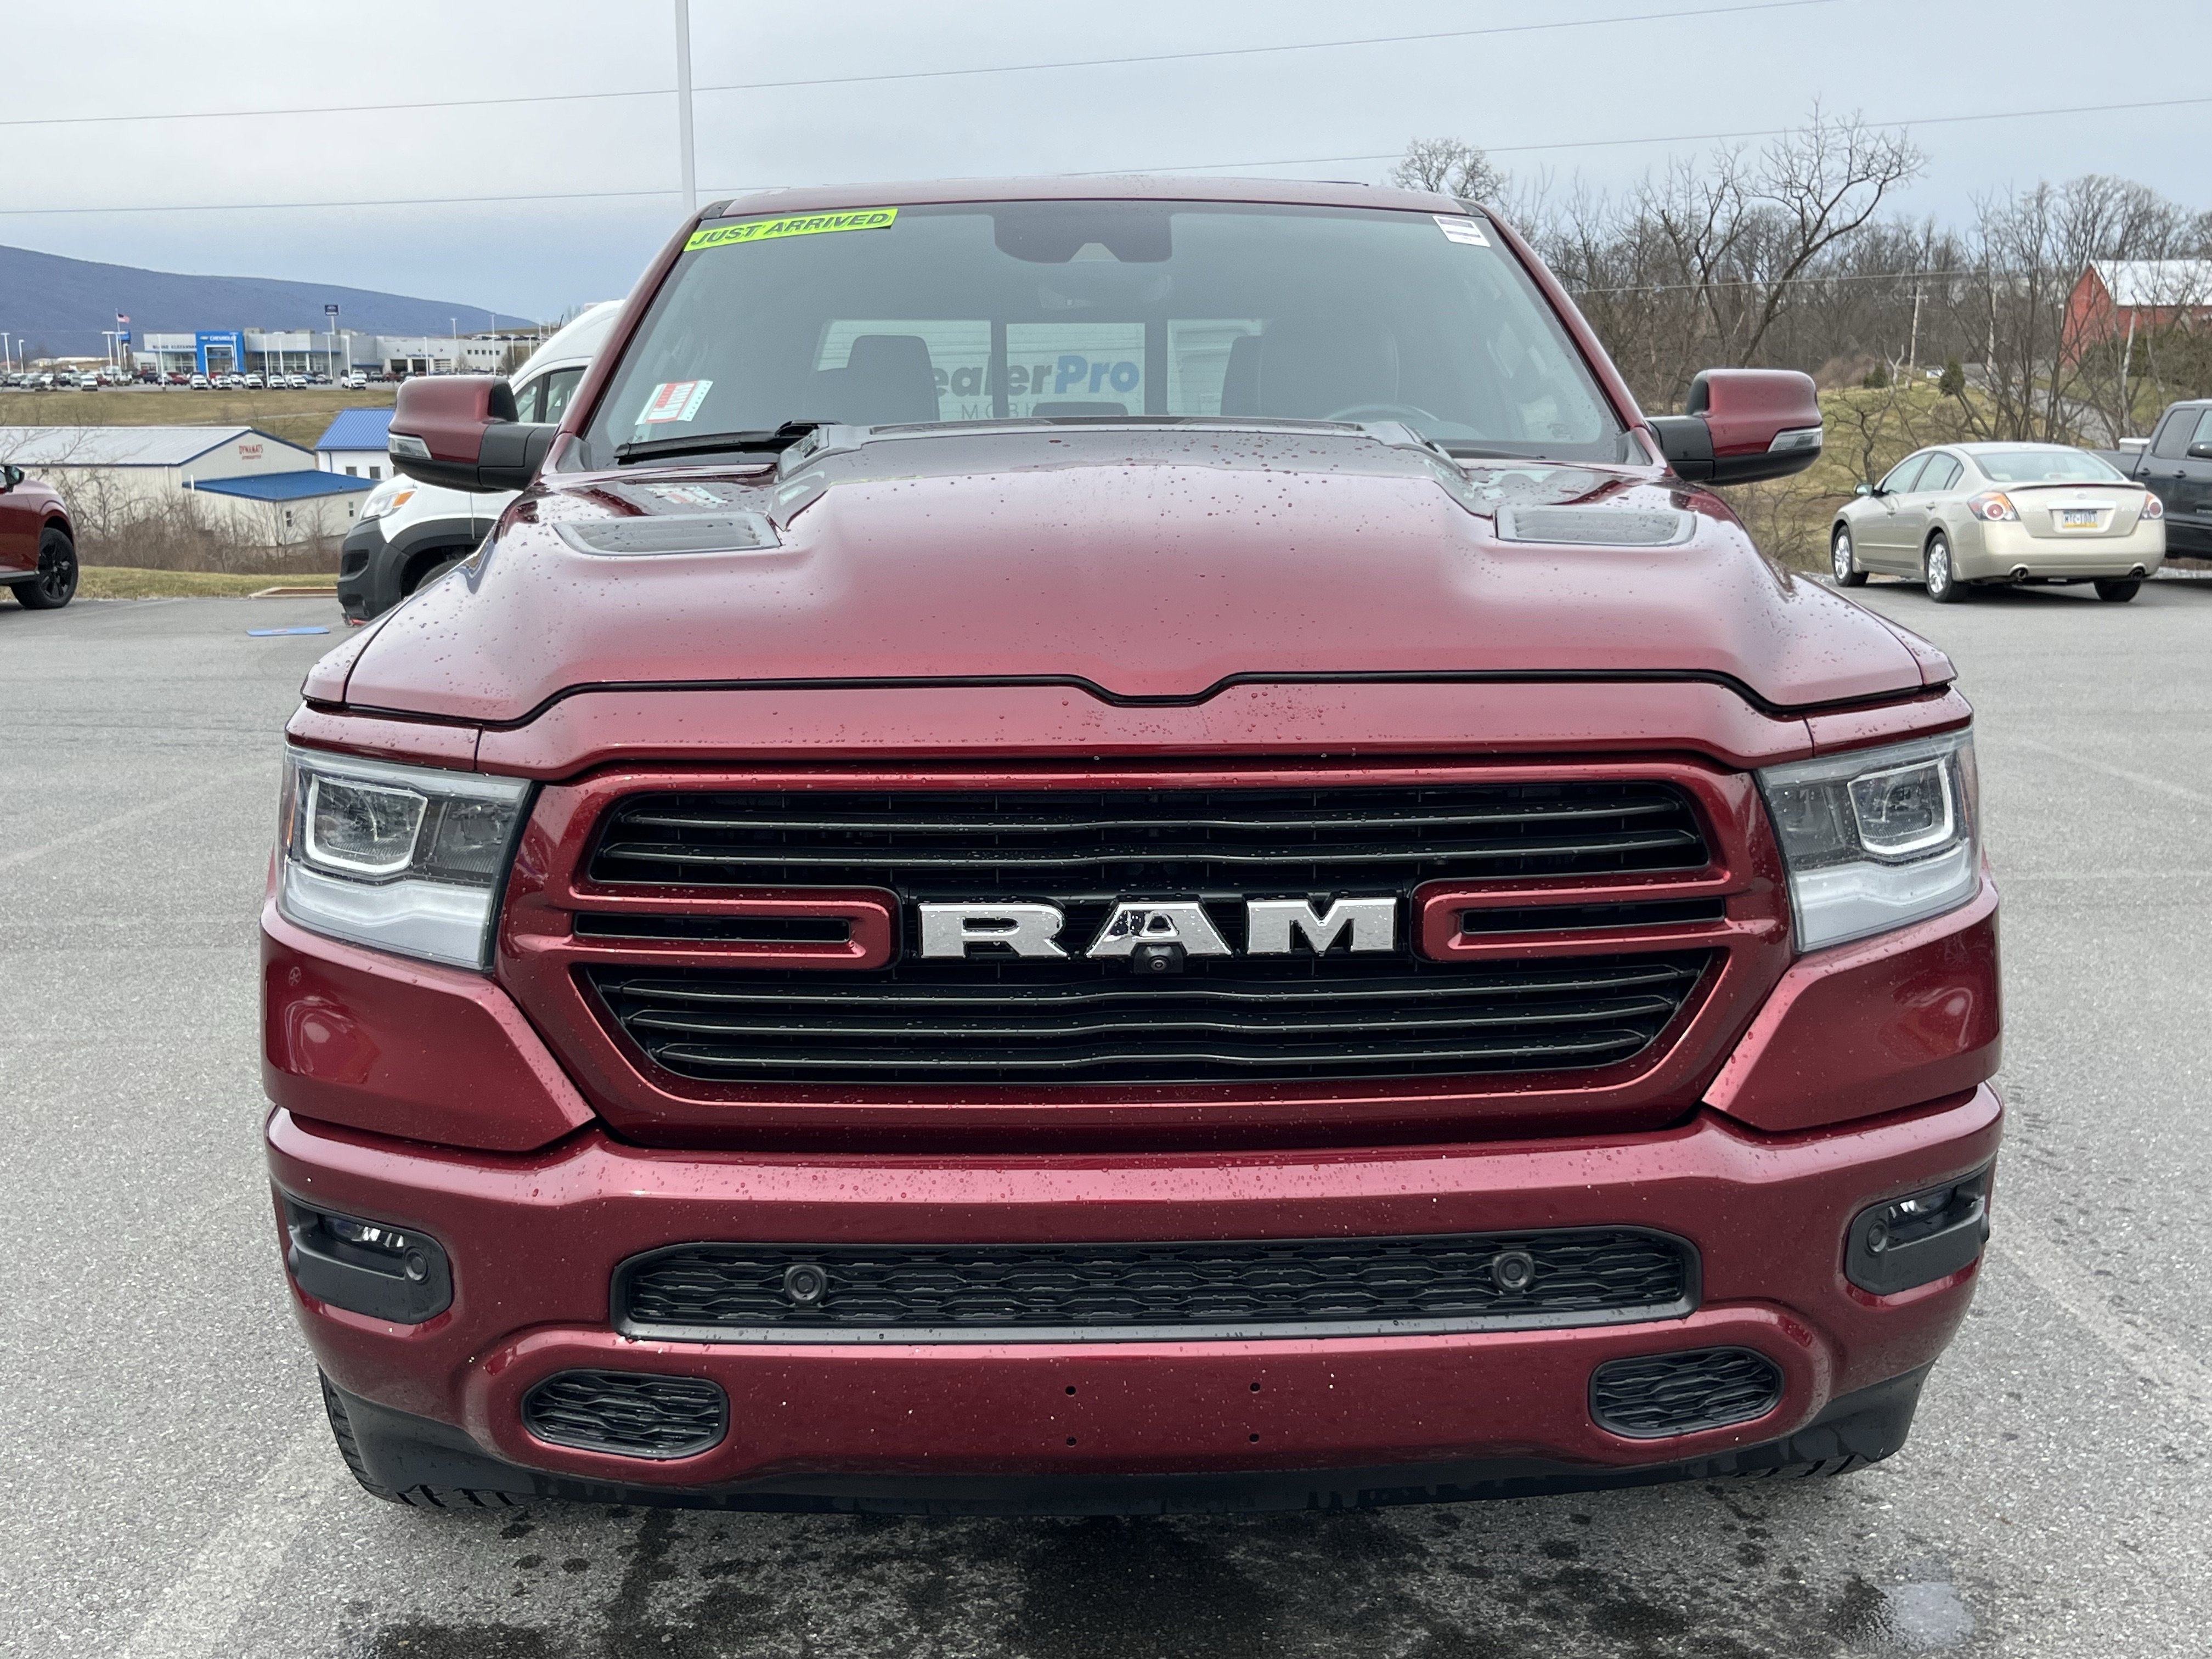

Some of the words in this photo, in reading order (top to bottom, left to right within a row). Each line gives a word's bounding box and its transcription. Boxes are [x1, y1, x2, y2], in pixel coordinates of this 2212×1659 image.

[690, 224, 765, 246] JUST
[763, 212, 892, 235] ARRIVED
[933, 355, 1139, 397] ealerPro
[917, 898, 1398, 958] RAM
